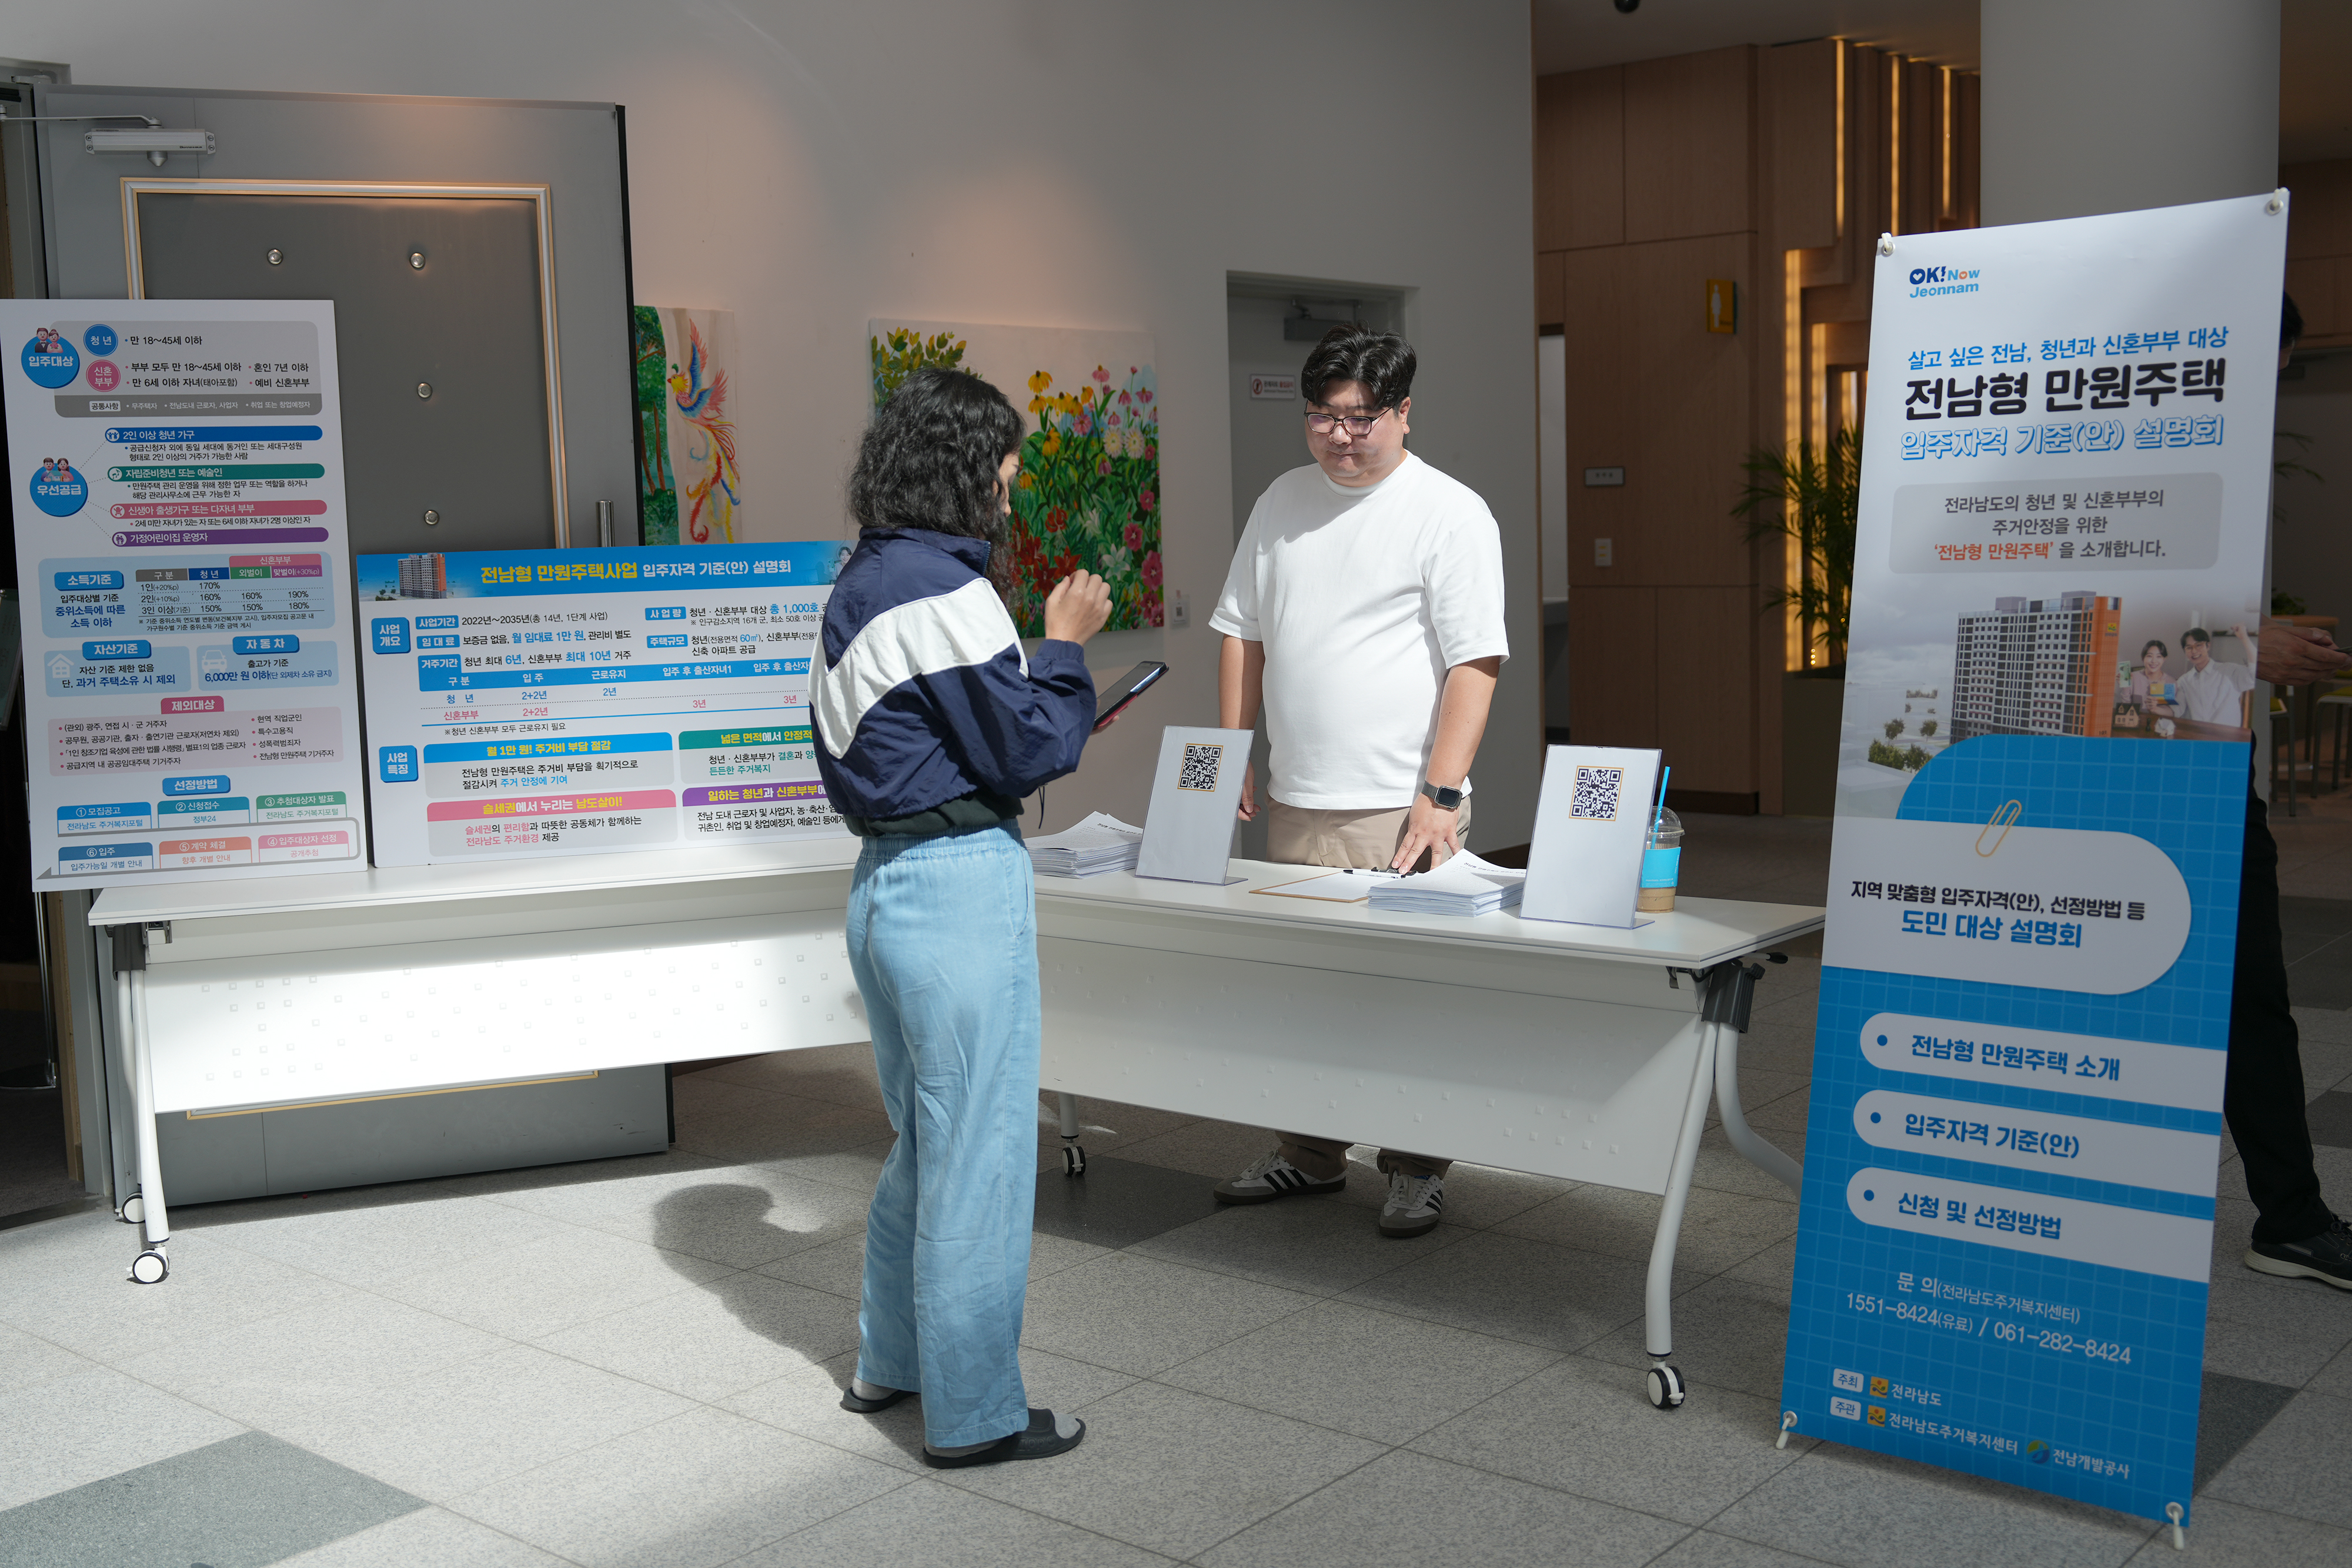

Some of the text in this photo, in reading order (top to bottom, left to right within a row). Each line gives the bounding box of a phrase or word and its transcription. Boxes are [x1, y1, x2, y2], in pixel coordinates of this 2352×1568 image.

[1909, 266, 1980, 285] OK! Now
[1909, 283, 1979, 298] Jeonnam
[130, 336, 139, 345] 만
[185, 336, 202, 345] 이하
[1908, 325, 2229, 370] 살고 싶은 전남, 청년과 신혼부부 대상
[28, 356, 74, 366] 입주대상
[94, 366, 112, 376] 신혼
[131, 363, 149, 372] 부부
[152, 363, 169, 372] 모두
[172, 362, 181, 372] 만
[224, 362, 241, 371] 이하
[253, 363, 309, 372] 혼인 7년 이하
[95, 377, 113, 387] 부부
[1905, 357, 2226, 420] 전남형 만원주택
[123, 430, 195, 440] 2인 이상 청년 가구
[1900, 414, 2224, 460] 입주자격 기준(안) 설명회
[125, 467, 222, 478] 자립준비청년 또는 예술인
[37, 484, 81, 496] 우선공급
[1945, 489, 2163, 513] 전라남도의 청년 및 신혼부부의
[128, 504, 255, 515] 신생아 출생가구 또는 다자녀 부부
[1992, 516, 2107, 536] 주거안정을 위한
[130, 532, 208, 543] 가정어린이집 운영자
[2080, 539, 2166, 558] 소개합니다.
[481, 559, 791, 583] 전남형 만원주택사업 입주자격 기준(안) 설명회
[68, 574, 111, 585] 소득기준
[60, 593, 119, 603] 입주대상별 기준
[200, 593, 221, 603] 160%
[240, 592, 262, 602] 160%
[288, 590, 309, 601] 190%
[419, 617, 455, 627] 사업기간
[544, 613, 563, 622] 14년,
[566, 613, 586, 621] 1단계
[589, 611, 607, 620] 사업)
[379, 624, 400, 634] 사업
[380, 636, 400, 646] 개요
[463, 630, 632, 645] 보증금 없음, 월 임대료 1만 원, 관리비 별도
[94, 643, 138, 654] 자산기준
[691, 645, 756, 656] 신축 아파트 공급
[422, 658, 458, 668] 거주기간
[464, 650, 631, 667] 청년 최대 6년, 신혼부부 최대 10년 거주
[591, 669, 626, 680] 근로유지
[522, 690, 547, 700] 2+2년
[603, 687, 616, 696] 2년
[172, 699, 215, 711] 제외대상
[443, 710, 479, 720] 신혼부부
[487, 740, 611, 756] 월 1만 원! 주거비 부담 절감
[259, 749, 334, 760] 전남형 만원주택 기거주자
[387, 752, 407, 763] 사업
[387, 764, 408, 774] 특징
[462, 760, 638, 778] 전남형 만원주택은 주거비 부담을 획기적으로
[709, 764, 770, 775] 든든한 주거복지
[174, 778, 217, 791] 선정방법
[483, 796, 622, 814] 슬세권에서 누리는 남도살이!
[193, 815, 216, 823] 정부24
[466, 832, 559, 847] 전라남도 주거환경 제공
[1851, 881, 2144, 920] 지역 맞춤형 입주자격(안), 선정방법 등
[1901, 910, 2082, 948] 도민 대상 설명회
[1912, 1034, 2120, 1081] 전남형 만원주택 소개
[1905, 1113, 2079, 1158] 입주자격 기준(안)
[1898, 1192, 2061, 1238] 신청 및 선정방법
[1847, 1292, 1973, 1333] 1551-8424(유료)
[1994, 1321, 2131, 1364] 061-282-8424
[1838, 1373, 1941, 1406] 주최 전라남도
[1835, 1401, 2130, 1479] 주관 전라남도주거복지센터 전남개발공사
